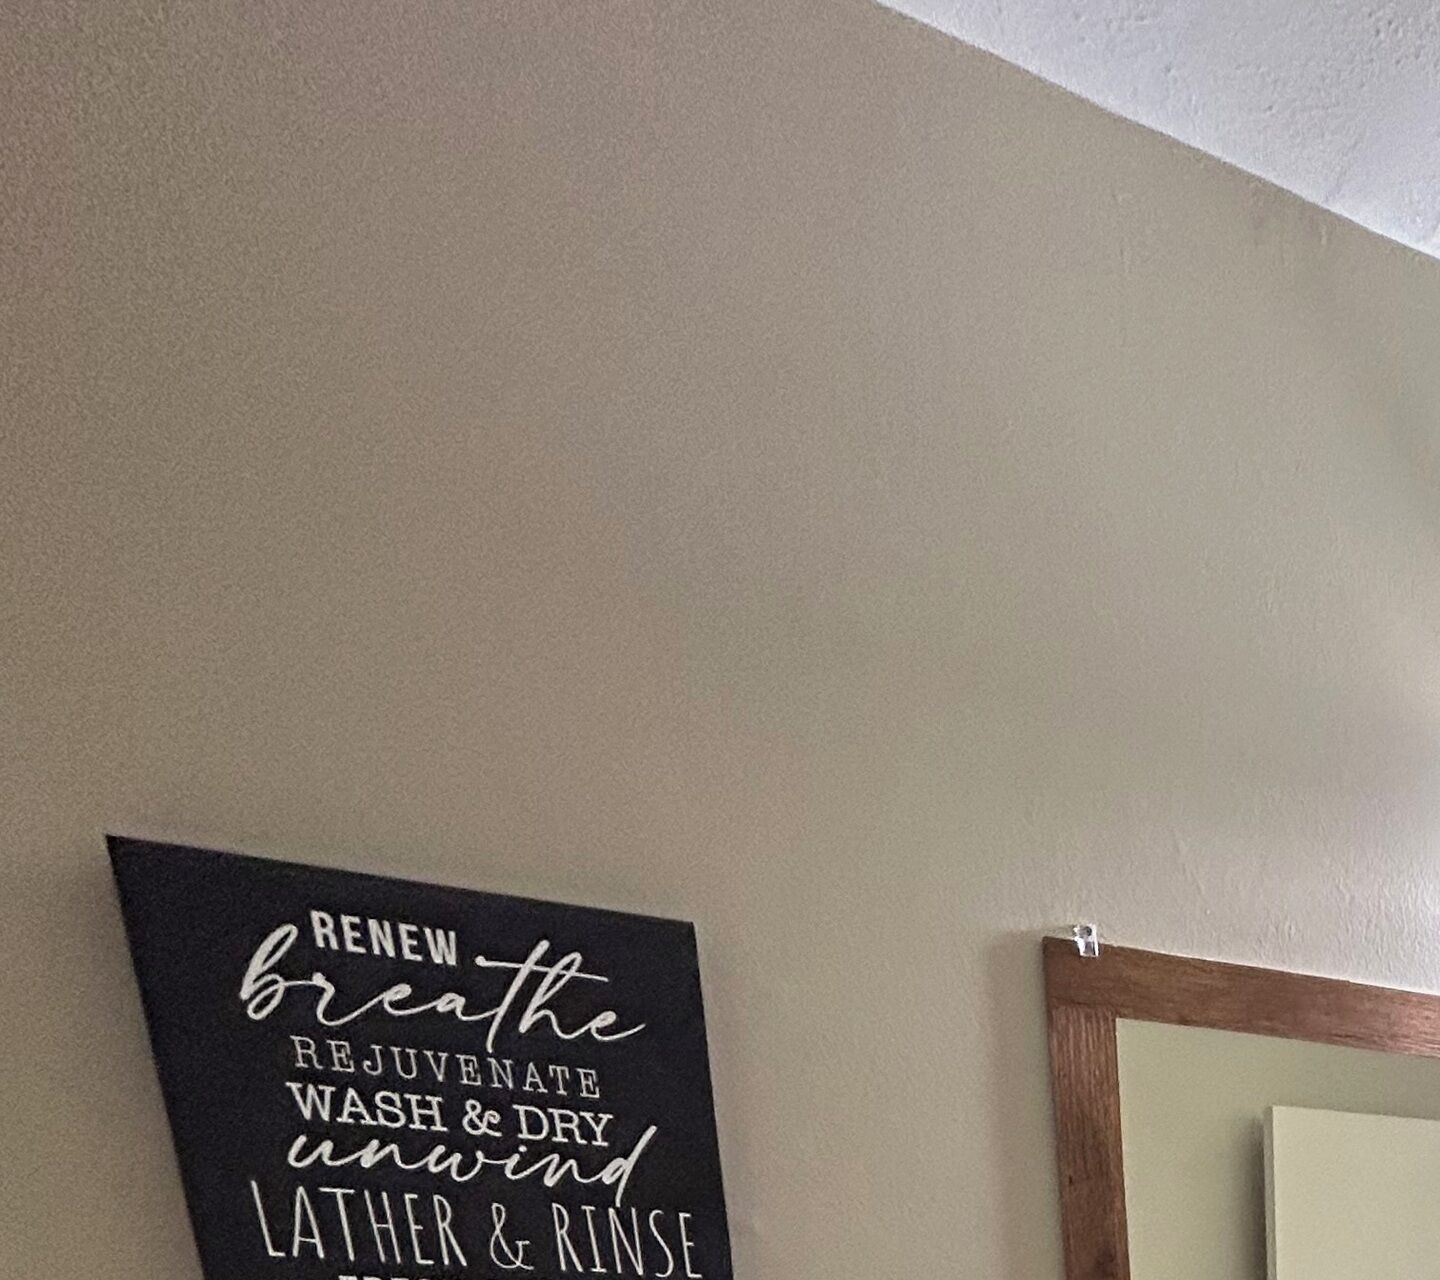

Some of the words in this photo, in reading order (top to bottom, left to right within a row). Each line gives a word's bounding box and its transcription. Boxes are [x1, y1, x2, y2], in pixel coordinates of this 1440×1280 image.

[310, 910, 457, 966] RENEW
[239, 924, 646, 1053] breathe
[290, 1034, 600, 1099] REJUVENATE
[285, 1081, 449, 1132] WASH
[462, 1099, 502, 1137] &
[513, 1104, 613, 1147] DRY
[287, 1125, 657, 1206] unwind
[250, 1180, 467, 1268] LATHER
[490, 1202, 535, 1271] &
[551, 1202, 703, 1279] RINSE
